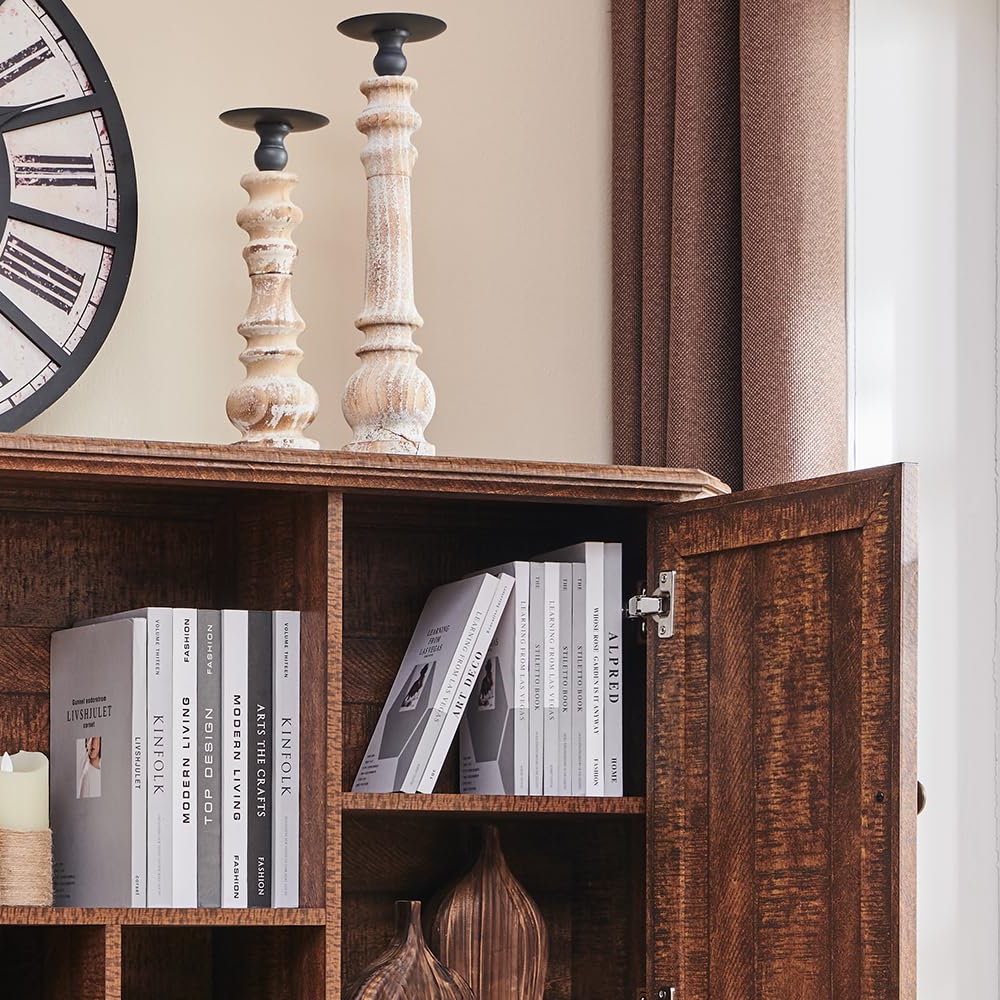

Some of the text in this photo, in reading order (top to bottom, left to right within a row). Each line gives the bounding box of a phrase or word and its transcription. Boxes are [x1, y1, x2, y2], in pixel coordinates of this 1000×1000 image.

[434, 612, 482, 723] LEARNING FROM LAS VEGAS
[452, 651, 482, 718] ART DECO
[608, 632, 619, 704] ALPRED
[66, 706, 112, 722] LIVSHJULET
[153, 714, 164, 795] KINFOLK
[204, 708, 214, 824] TOP DESIGN
[256, 704, 265, 818] ARTS THE CRAFTS
[281, 717, 291, 796] KINFOLK
